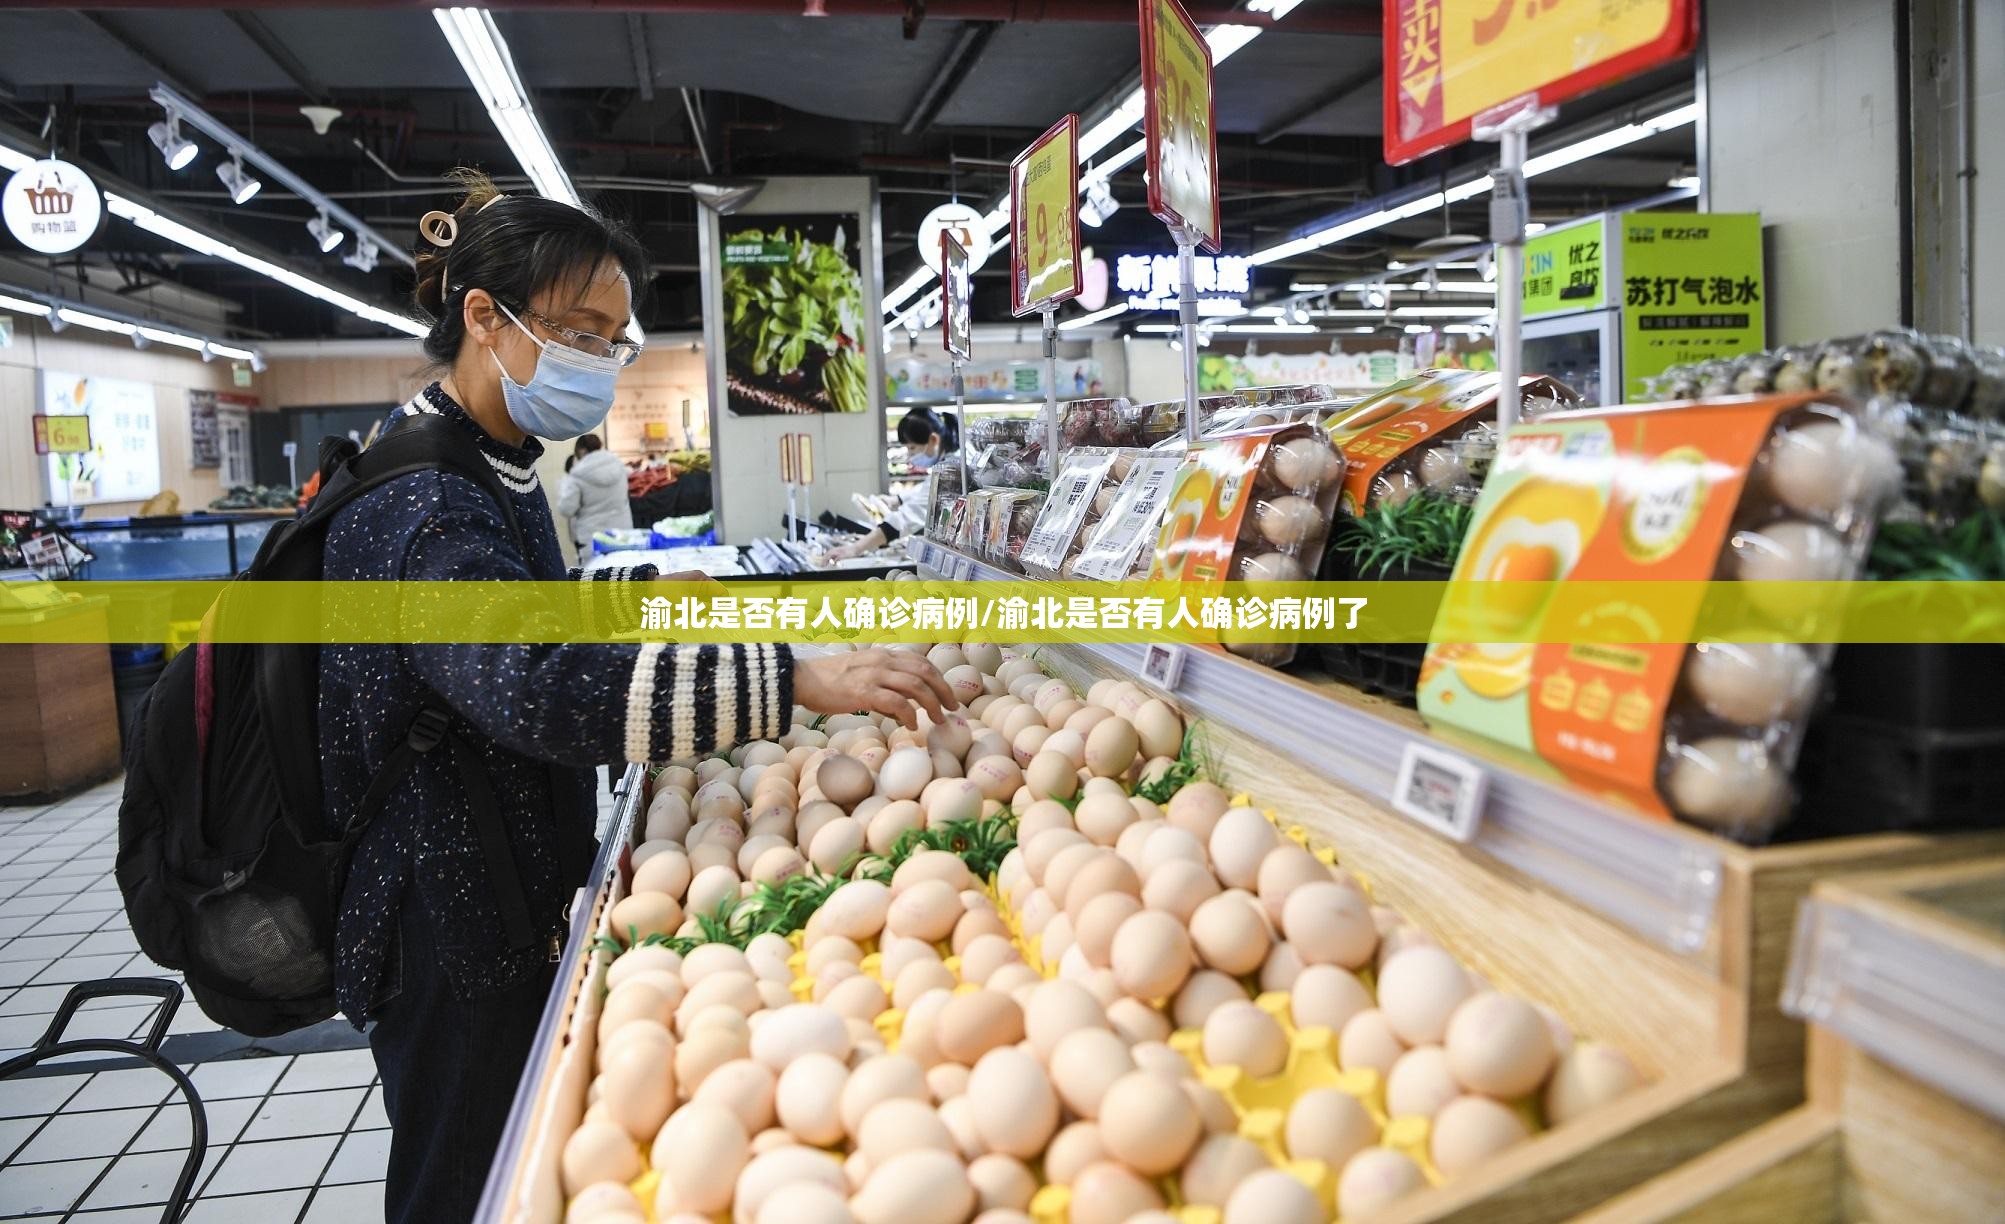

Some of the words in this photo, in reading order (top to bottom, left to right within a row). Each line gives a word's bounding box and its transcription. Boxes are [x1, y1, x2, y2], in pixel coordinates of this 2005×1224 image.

[31, 220, 77, 234] 购物篮
[1625, 276, 1759, 306] 苏打气泡水
